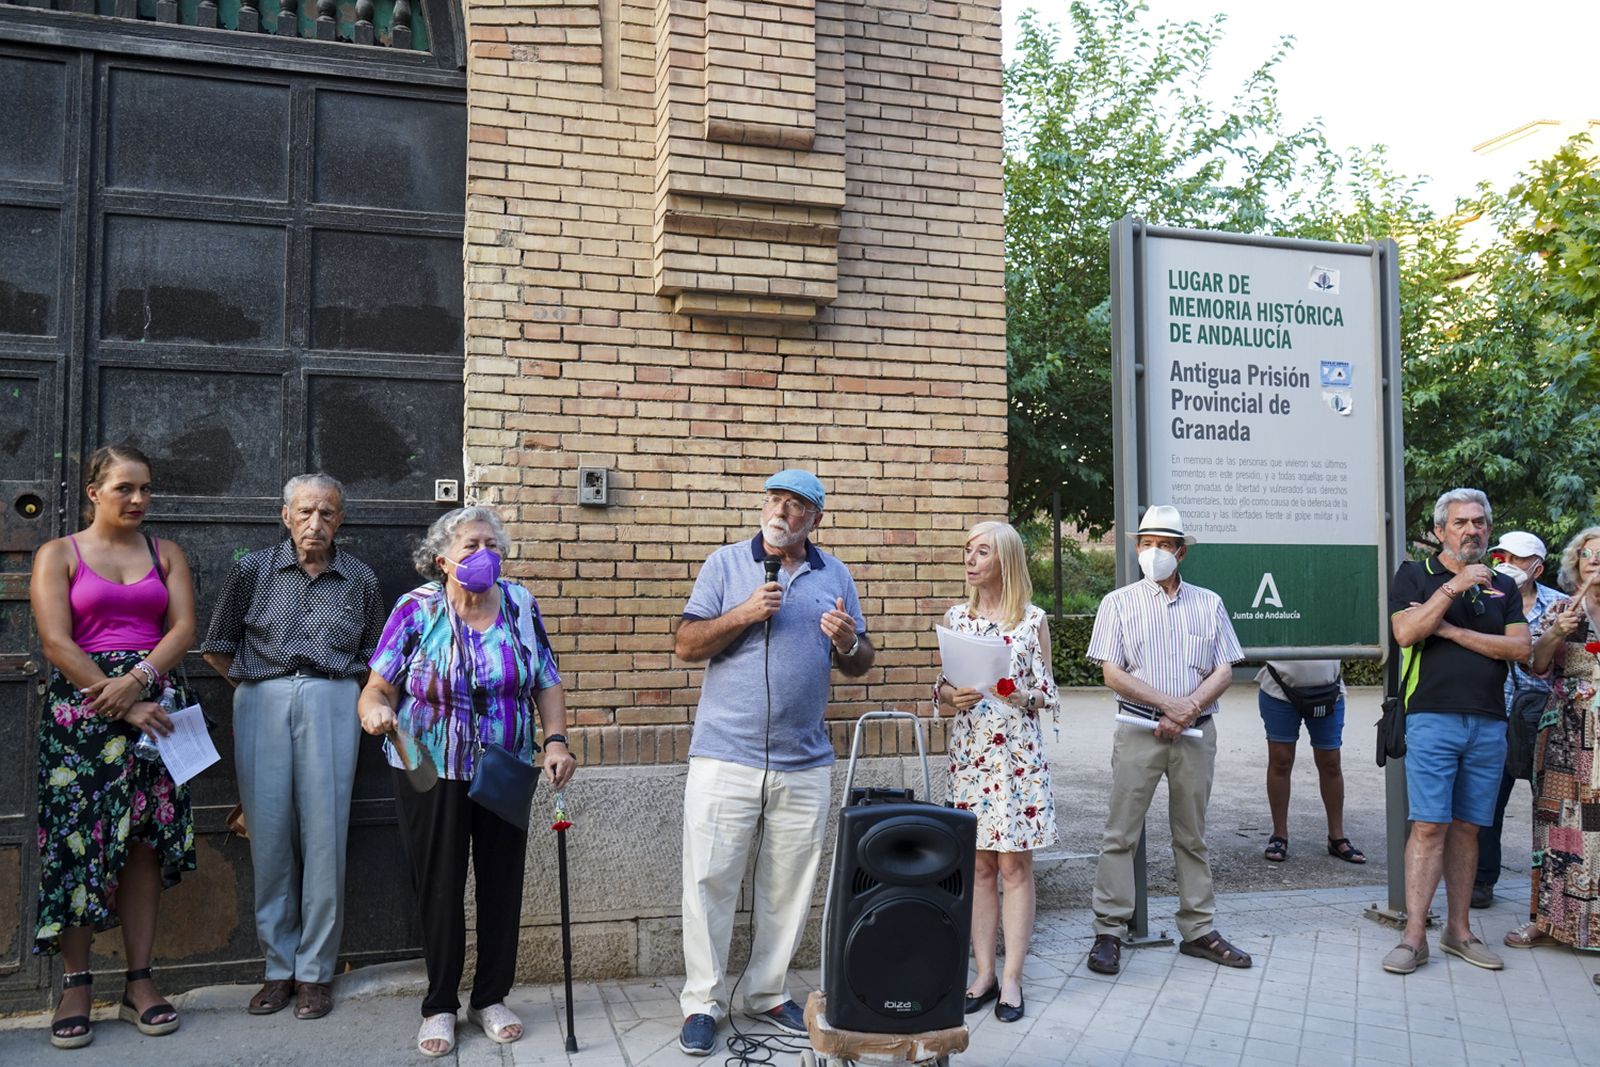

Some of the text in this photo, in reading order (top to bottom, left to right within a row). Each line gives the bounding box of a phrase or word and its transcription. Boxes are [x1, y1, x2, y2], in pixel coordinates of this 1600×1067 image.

[1168, 269, 1250, 294] LUGAR DE
[1169, 296, 1344, 327] MEMORIA HISTÓRICA
[1170, 322, 1292, 349] DE ANDALUCÍA
[1170, 360, 1310, 388] Antigua Prisión
[1171, 388, 1291, 415] Provincial de
[1171, 416, 1251, 441] Granada
[1171, 454, 1181, 464] En
[1183, 456, 1213, 465] memoria
[1215, 456, 1224, 465] de
[1227, 456, 1236, 466] las
[1239, 458, 1268, 467] personas
[1270, 459, 1282, 468] que
[1285, 459, 1308, 468] vivieron
[1311, 460, 1321, 468] sus
[1172, 470, 1206, 478] momentos
[1220, 471, 1233, 479] este
[1279, 471, 1296, 480] todas
[1298, 472, 1323, 482] aquellas
[1326, 474, 1338, 483] que
[1340, 474, 1347, 482] se
[1172, 483, 1191, 491] vieron
[1195, 483, 1222, 493] privadas
[1224, 483, 1233, 492] de
[1236, 484, 1260, 493] libertad
[1269, 485, 1303, 494] vulnerados
[1320, 486, 1348, 495] derechos
[1223, 496, 1238, 505] todo
[1290, 498, 1299, 507] de
[1300, 499, 1306, 507] la
[1307, 498, 1331, 508] defensa
[1333, 499, 1340, 508] de
[1342, 499, 1348, 508] la
[1180, 510, 1210, 518] mocracia
[1220, 510, 1229, 519] las
[1232, 510, 1262, 520] libertades
[1265, 510, 1282, 520] frente
[1286, 511, 1292, 520] al
[1295, 512, 1311, 522] golpe
[1314, 512, 1333, 520] militar
[1343, 512, 1348, 520] la
[1182, 522, 1203, 531] tadura
[1232, 610, 1301, 619] Junta de Andalucía
[884, 1000, 912, 1009] ibiza
